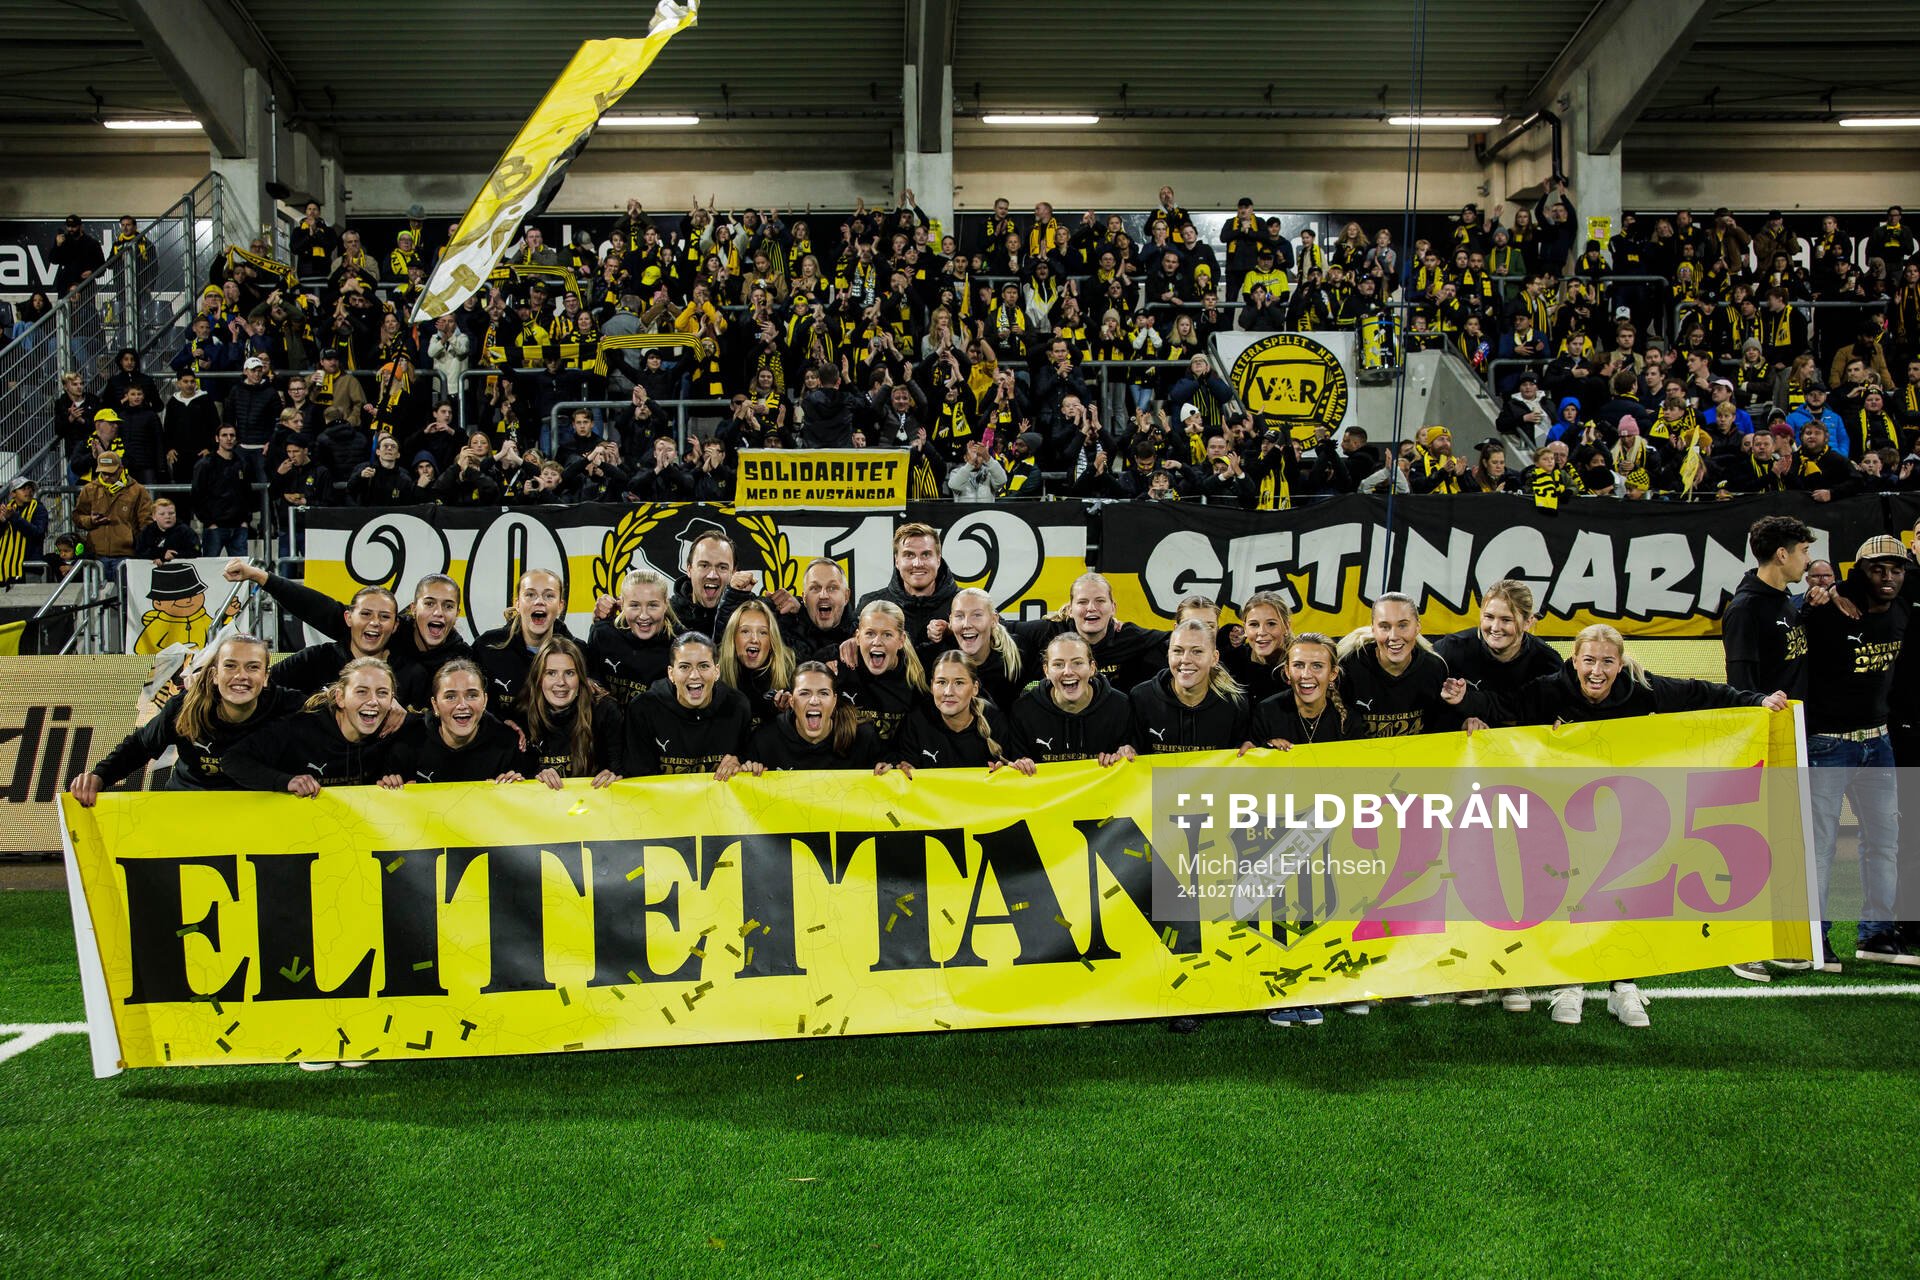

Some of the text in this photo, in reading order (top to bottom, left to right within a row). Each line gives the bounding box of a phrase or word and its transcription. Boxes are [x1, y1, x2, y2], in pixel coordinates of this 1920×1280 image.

[1263, 335, 1309, 348] SPELET
[1317, 348, 1337, 369] NEJ
[1334, 369, 1346, 395] TILL
[1256, 377, 1318, 404] VAR
[744, 461, 898, 482] SOLIDARITET
[747, 487, 896, 500] MED DE AVSTÄNGDA
[1145, 523, 1830, 618] GETINGARN
[116, 759, 1773, 1005] ELITETTAN 2025
